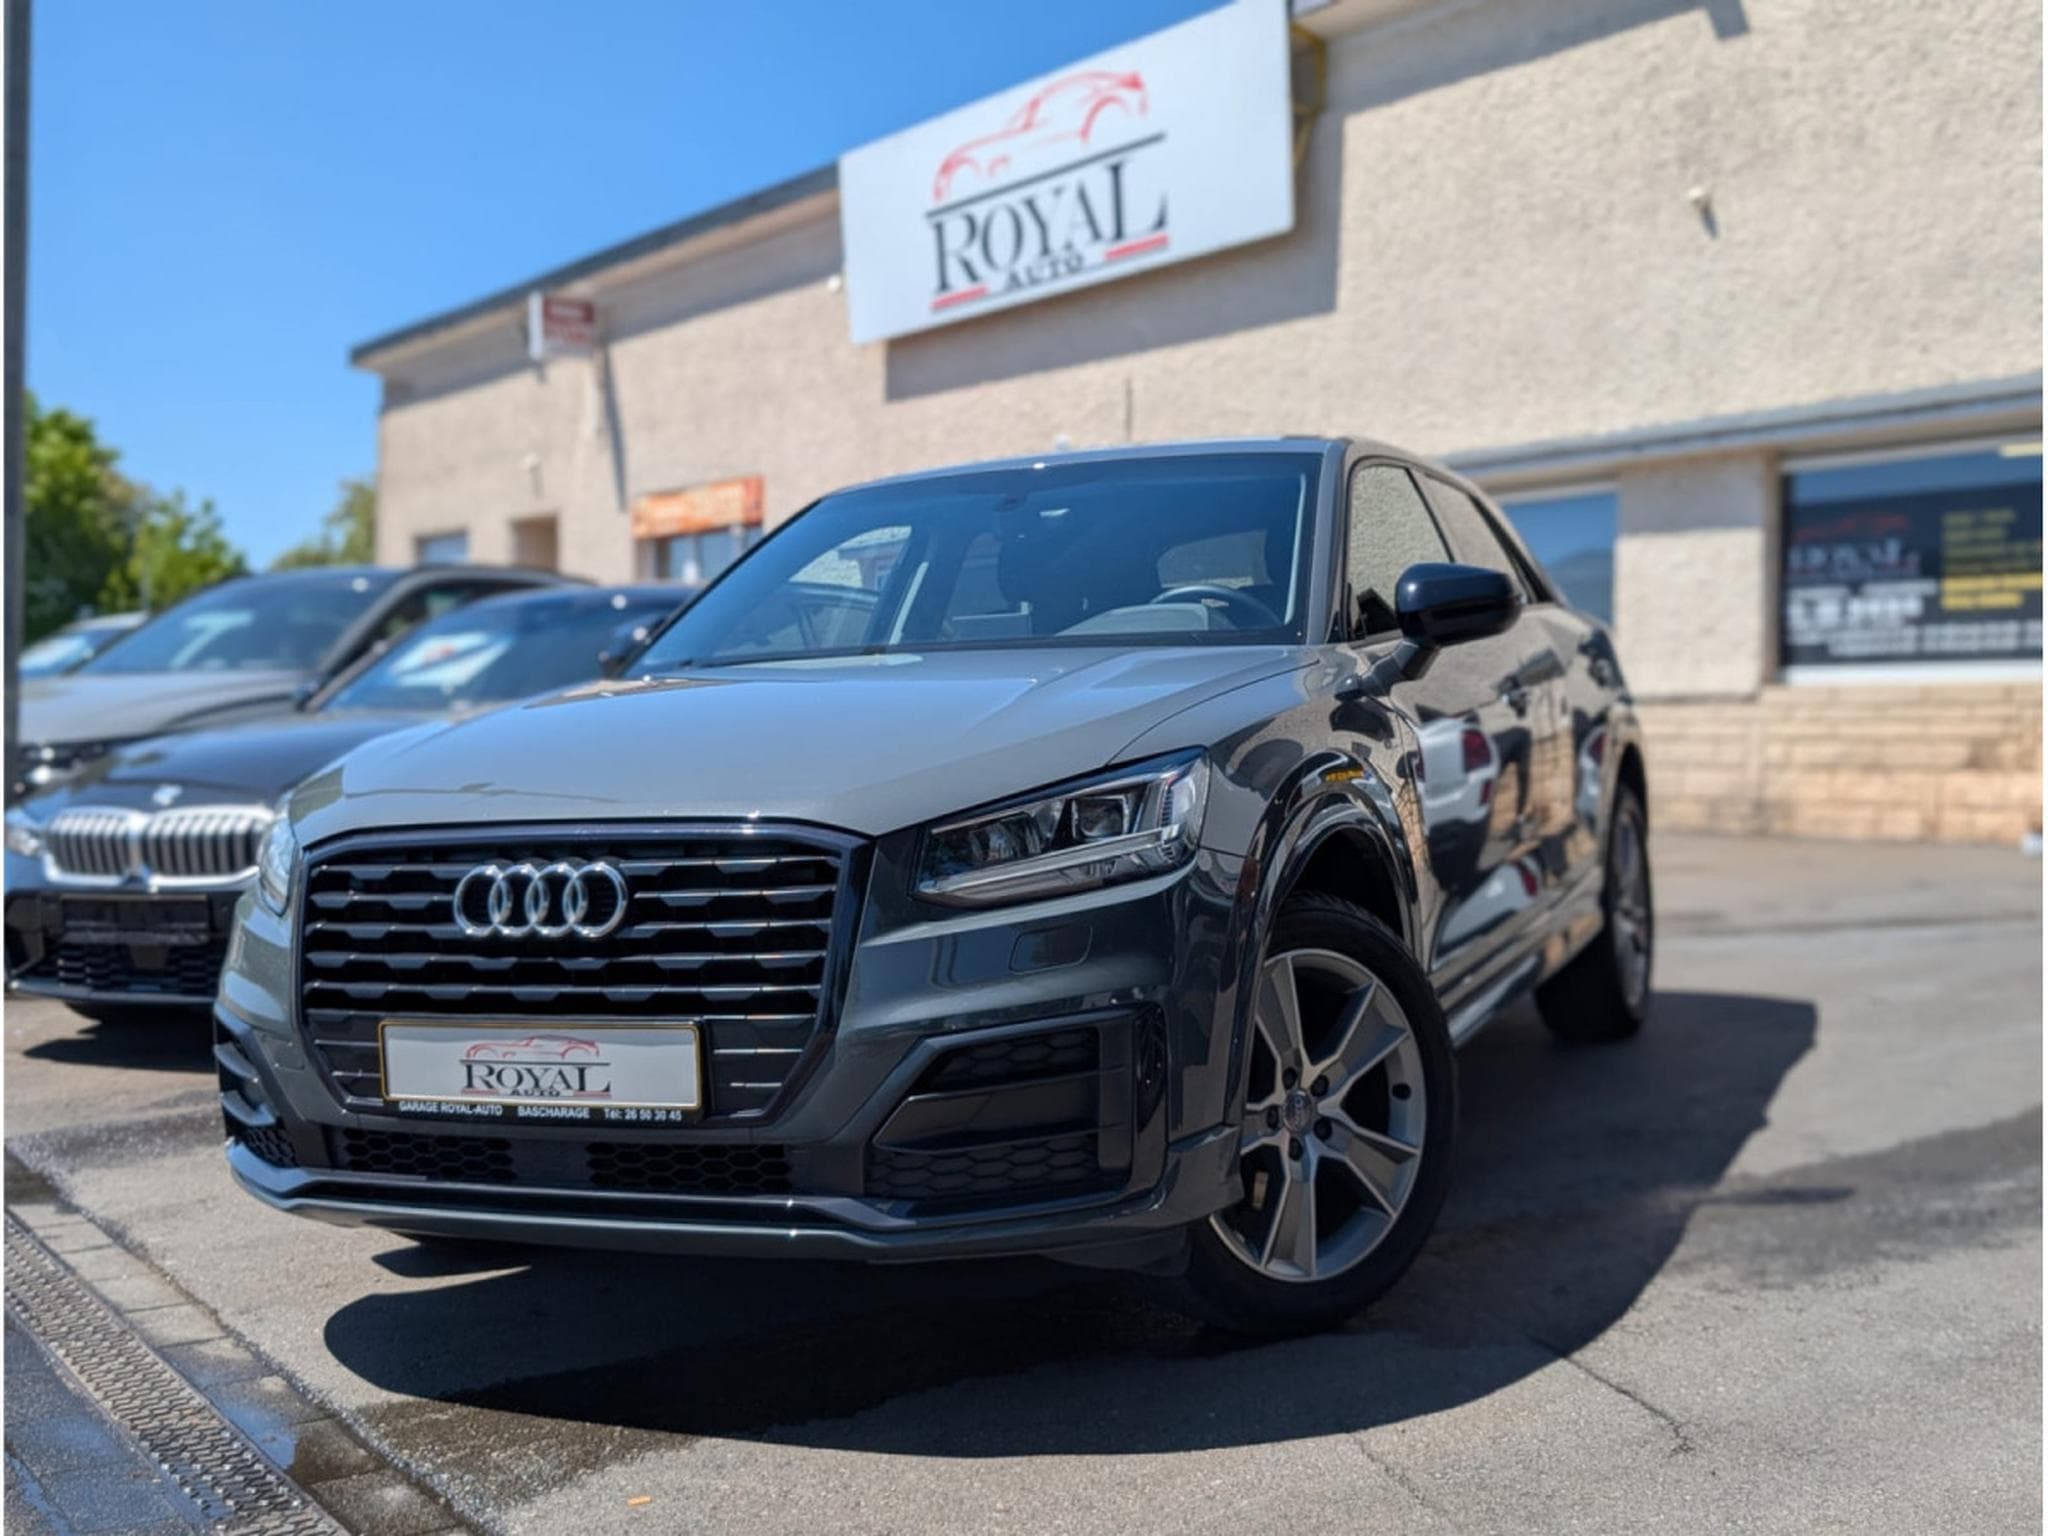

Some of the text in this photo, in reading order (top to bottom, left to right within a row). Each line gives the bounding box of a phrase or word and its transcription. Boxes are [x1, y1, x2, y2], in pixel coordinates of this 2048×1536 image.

[932, 158, 1169, 293] ROYAL
[1004, 250, 1085, 293] AUTO
[464, 1063, 611, 1092] ROYAL
[509, 1087, 561, 1098] AUTO
[399, 1100, 438, 1113] GARAGE
[440, 1102, 504, 1117] ROYAL-AUTO
[517, 1105, 591, 1119] BASCHARAGE
[668, 1110, 683, 1122] 45
